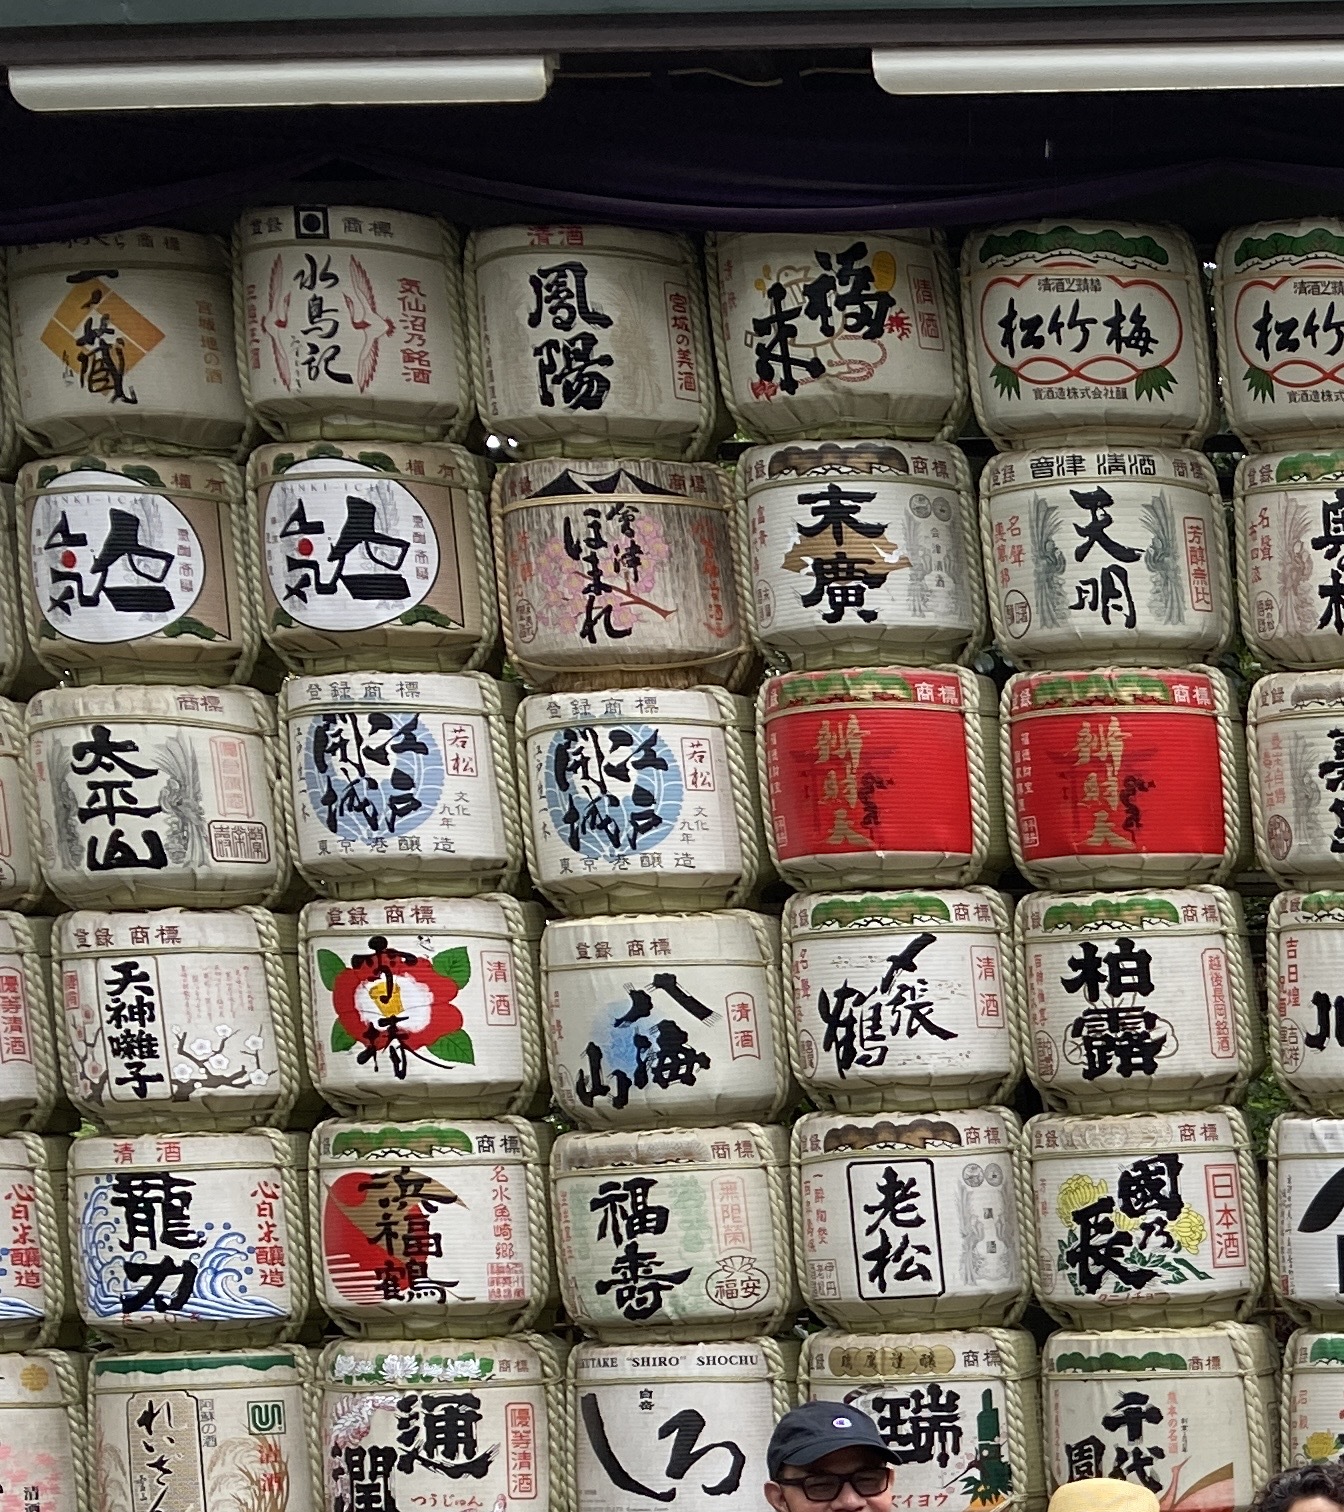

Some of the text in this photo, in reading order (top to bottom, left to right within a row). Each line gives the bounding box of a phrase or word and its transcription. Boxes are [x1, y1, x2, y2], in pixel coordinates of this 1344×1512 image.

[527, 226, 584, 247] 清酒
[294, 253, 353, 384] 水鳥記
[527, 261, 613, 410] 鳳陽
[670, 293, 696, 391] 宮城の美酒
[998, 298, 1159, 358] 松竹梅
[1030, 454, 1156, 479] 會津 清酒
[564, 507, 632, 643] ほまれ
[795, 483, 892, 623] 末廣
[1070, 487, 1147, 629] 天明
[447, 727, 474, 774] 若松
[605, 728, 669, 849] 江戸
[686, 743, 713, 789] 若松
[70, 724, 167, 872] 太平山
[318, 837, 455, 855] 東京港醸造
[560, 853, 695, 874] 東京港醸造
[105, 961, 163, 1097] 天神囃子
[487, 960, 511, 1017] 清酒
[731, 1003, 754, 1048] 清酒
[976, 956, 999, 1018] 清酒
[1061, 937, 1168, 1081] 柏露
[576, 973, 715, 1109] 八海山
[113, 1141, 181, 1164] 清酒
[112, 1172, 206, 1314] 龍力
[490, 1165, 516, 1260] 名水魚崎郷
[862, 1166, 932, 1294] 老松
[1210, 1172, 1241, 1259] 日本酒
[697, 1355, 758, 1366] SHOCHU
[510, 1407, 534, 1494] 優等清酒
[581, 1393, 745, 1501] しろ
[411, 1492, 483, 1509] つうじゅん
